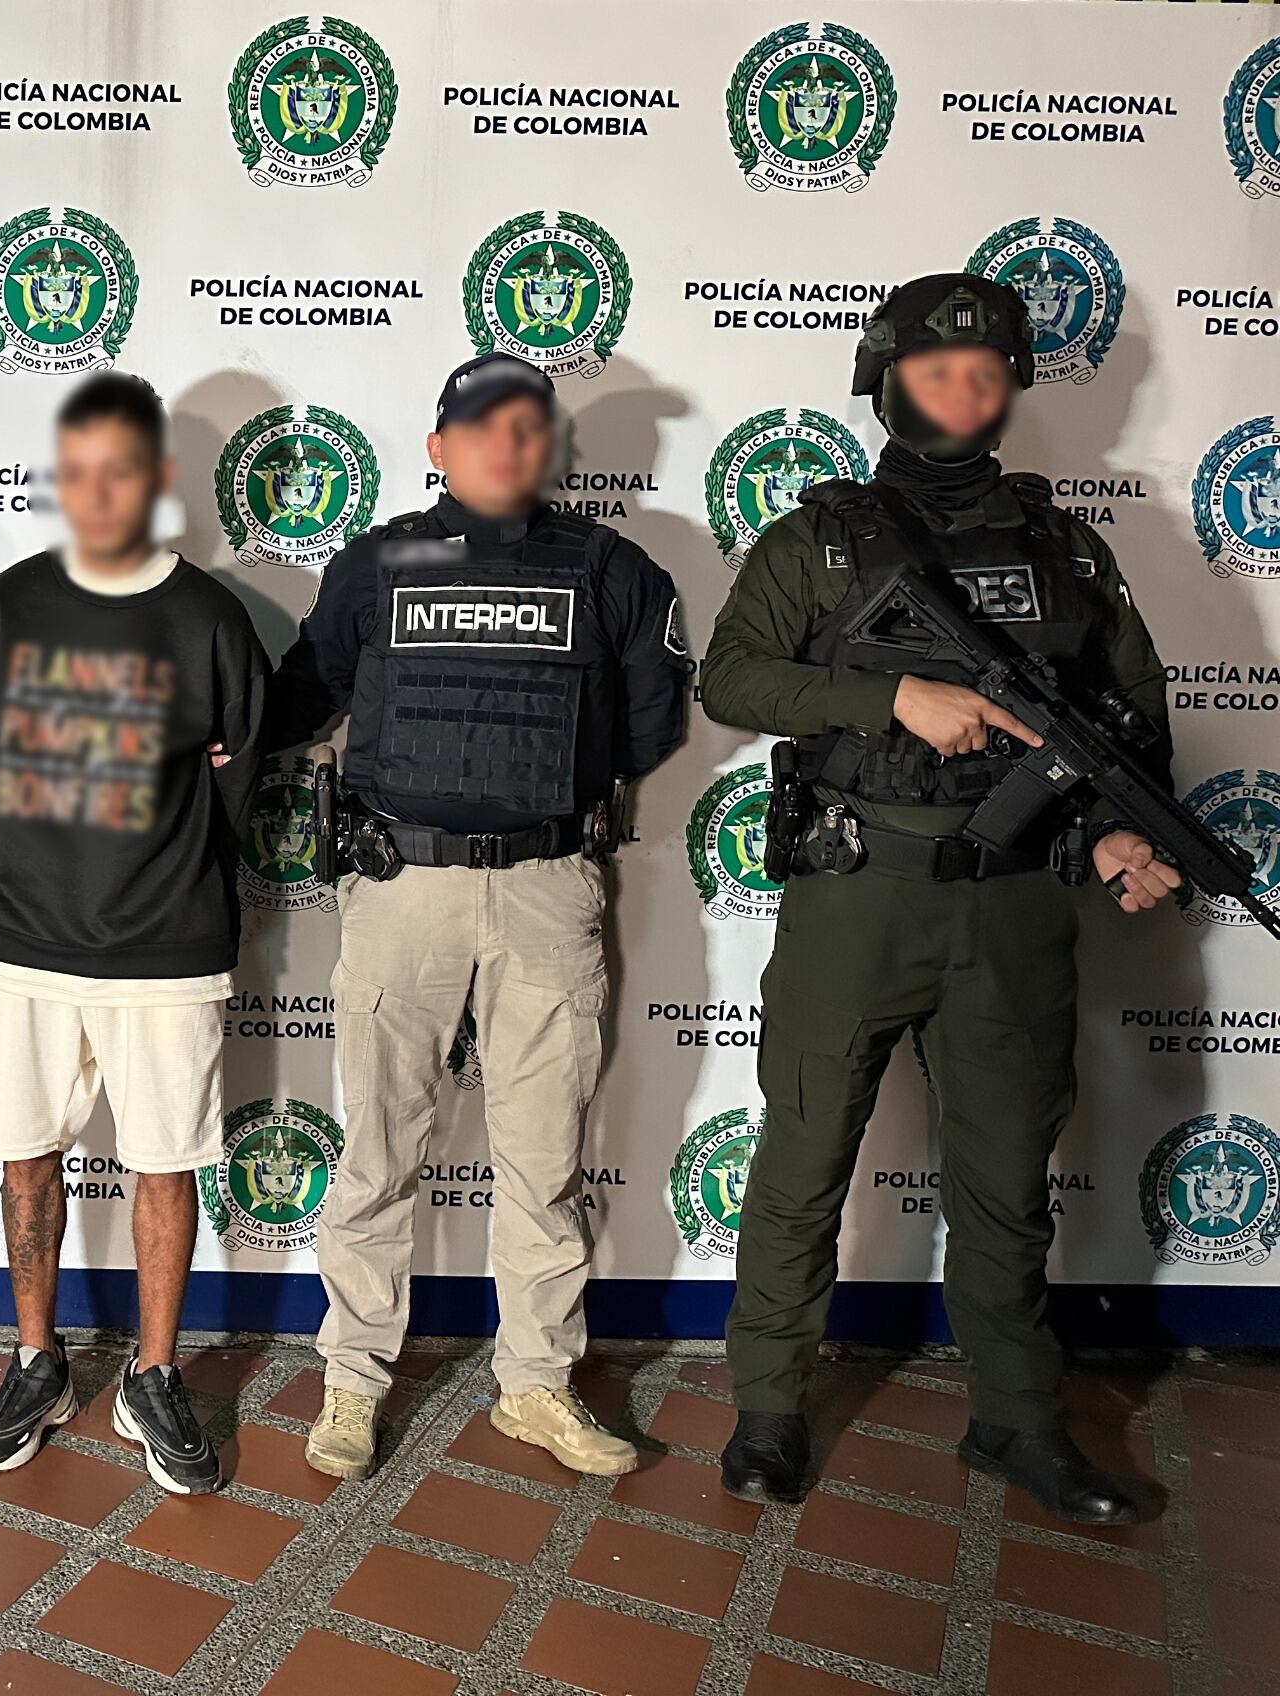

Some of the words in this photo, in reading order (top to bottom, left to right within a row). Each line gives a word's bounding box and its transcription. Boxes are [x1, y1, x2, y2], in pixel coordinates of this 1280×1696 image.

[807, 41, 826, 53] DE
[838, 49, 876, 118] COLOMBIA
[52, 83, 182, 103] NACIONAL
[443, 82, 543, 107] POLICÍA
[549, 88, 680, 109] NACIONAL
[942, 88, 1042, 113] POLICÍA
[1047, 94, 1178, 116] NACIONAL
[17, 111, 152, 132] COLOMBIA
[473, 115, 508, 135] DE
[513, 116, 649, 136] COLOMBIA
[971, 121, 1006, 141] DE
[1011, 122, 1145, 143] COLOMBIA
[808, 130, 869, 170] NACIONAL
[806, 169, 852, 188] PATRIA
[190, 274, 288, 298] POLICÍA
[294, 279, 424, 299] NACIONAL
[684, 278, 783, 301] POLICÍA
[788, 282, 895, 303] NACION
[1176, 285, 1274, 309] POLICÍA
[220, 307, 254, 326] DE
[259, 307, 393, 326] COLOMBIA
[714, 310, 748, 328] DE
[753, 311, 869, 330] COLOMBI
[1204, 317, 1239, 336] DE
[292, 423, 310, 434] DE
[322, 431, 360, 496] COLOMBIA
[1055, 478, 1147, 498] CIONAL
[296, 508, 354, 547] NACIONAL
[294, 545, 338, 564] PATRIA
[405, 602, 558, 633] INTERPOL
[1164, 661, 1242, 684] OLICÍA
[1174, 691, 1208, 710] DE
[1212, 692, 1280, 711] COLO
[271, 995, 334, 1013] NACI
[647, 999, 743, 1022] POLICÍA
[1120, 1005, 1215, 1028] POLICÍA
[1220, 1011, 1280, 1029] NACI
[676, 1029, 709, 1047] DE
[1148, 1035, 1181, 1053] DE
[419, 1160, 496, 1182] OLICÍA
[1243, 1137, 1277, 1199] COLOMBIA
[873, 1170, 940, 1188] POLIC
[65, 1182, 126, 1200] MBIA
[431, 1189, 463, 1207] DE
[901, 1197, 934, 1214] DE
[1213, 1210, 1271, 1246] NACIONAL
